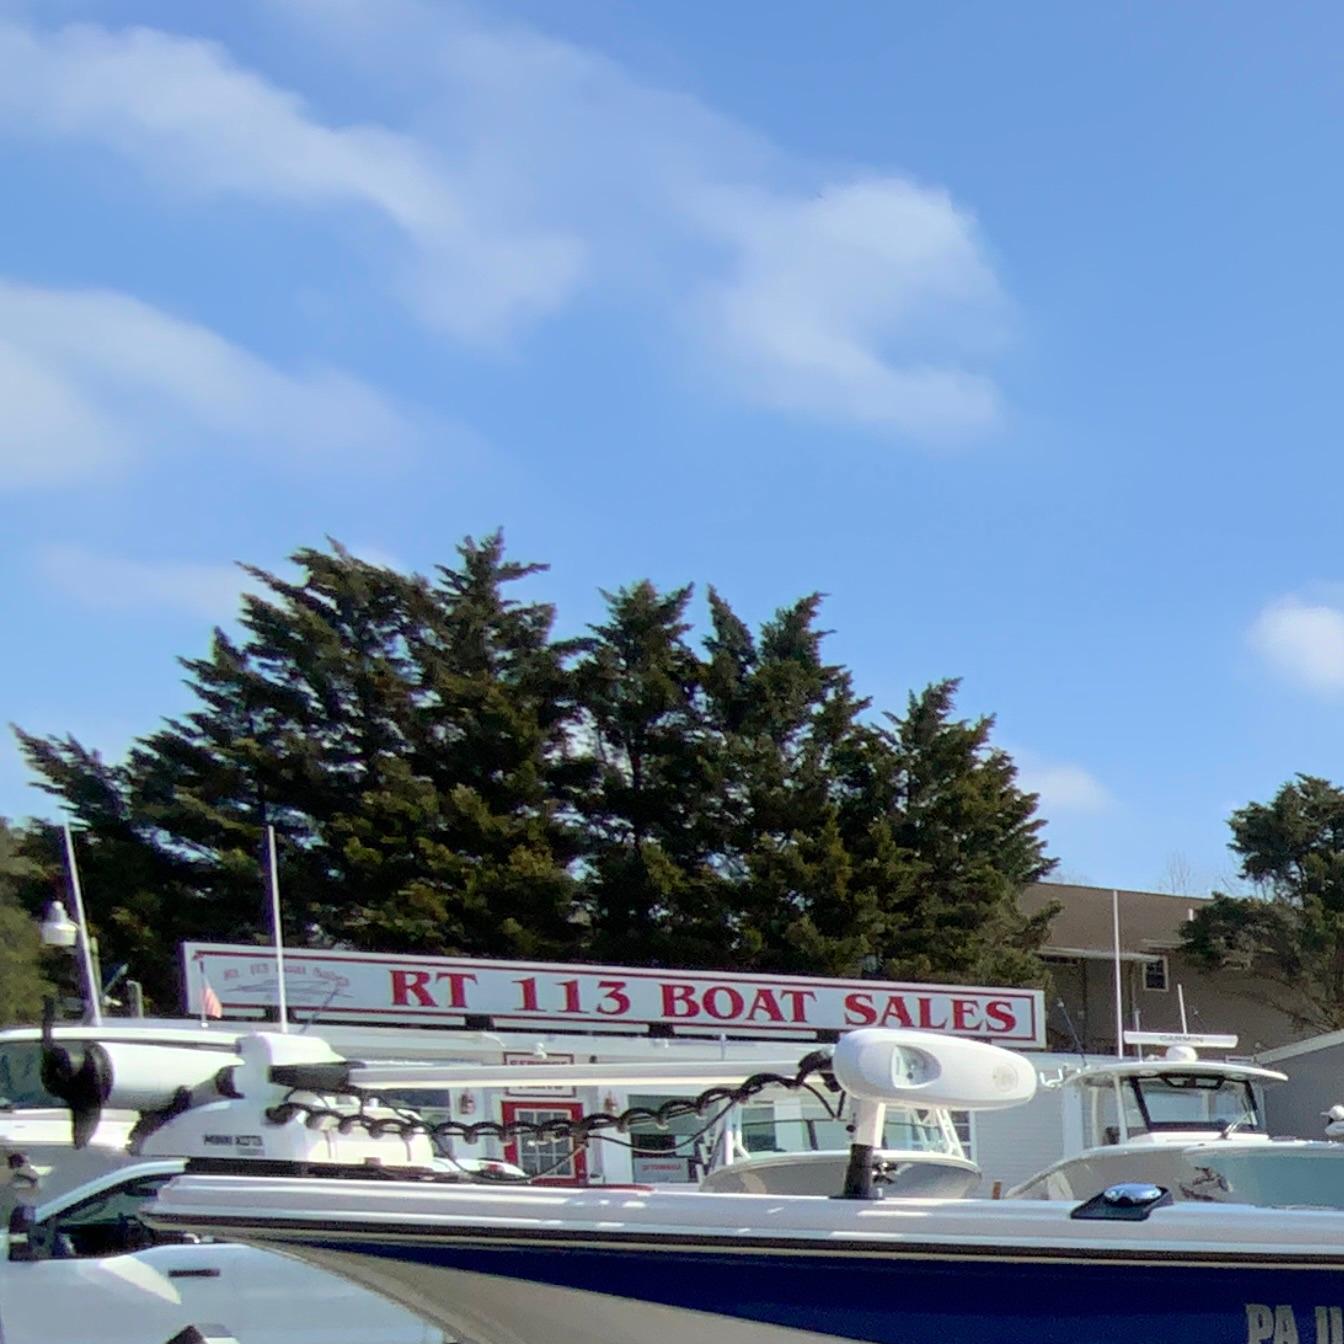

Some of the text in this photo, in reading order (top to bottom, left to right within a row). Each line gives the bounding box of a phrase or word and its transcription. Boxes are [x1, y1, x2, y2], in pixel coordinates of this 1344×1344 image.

[389, 969, 1017, 1032] RT 113 BOAT SALES
